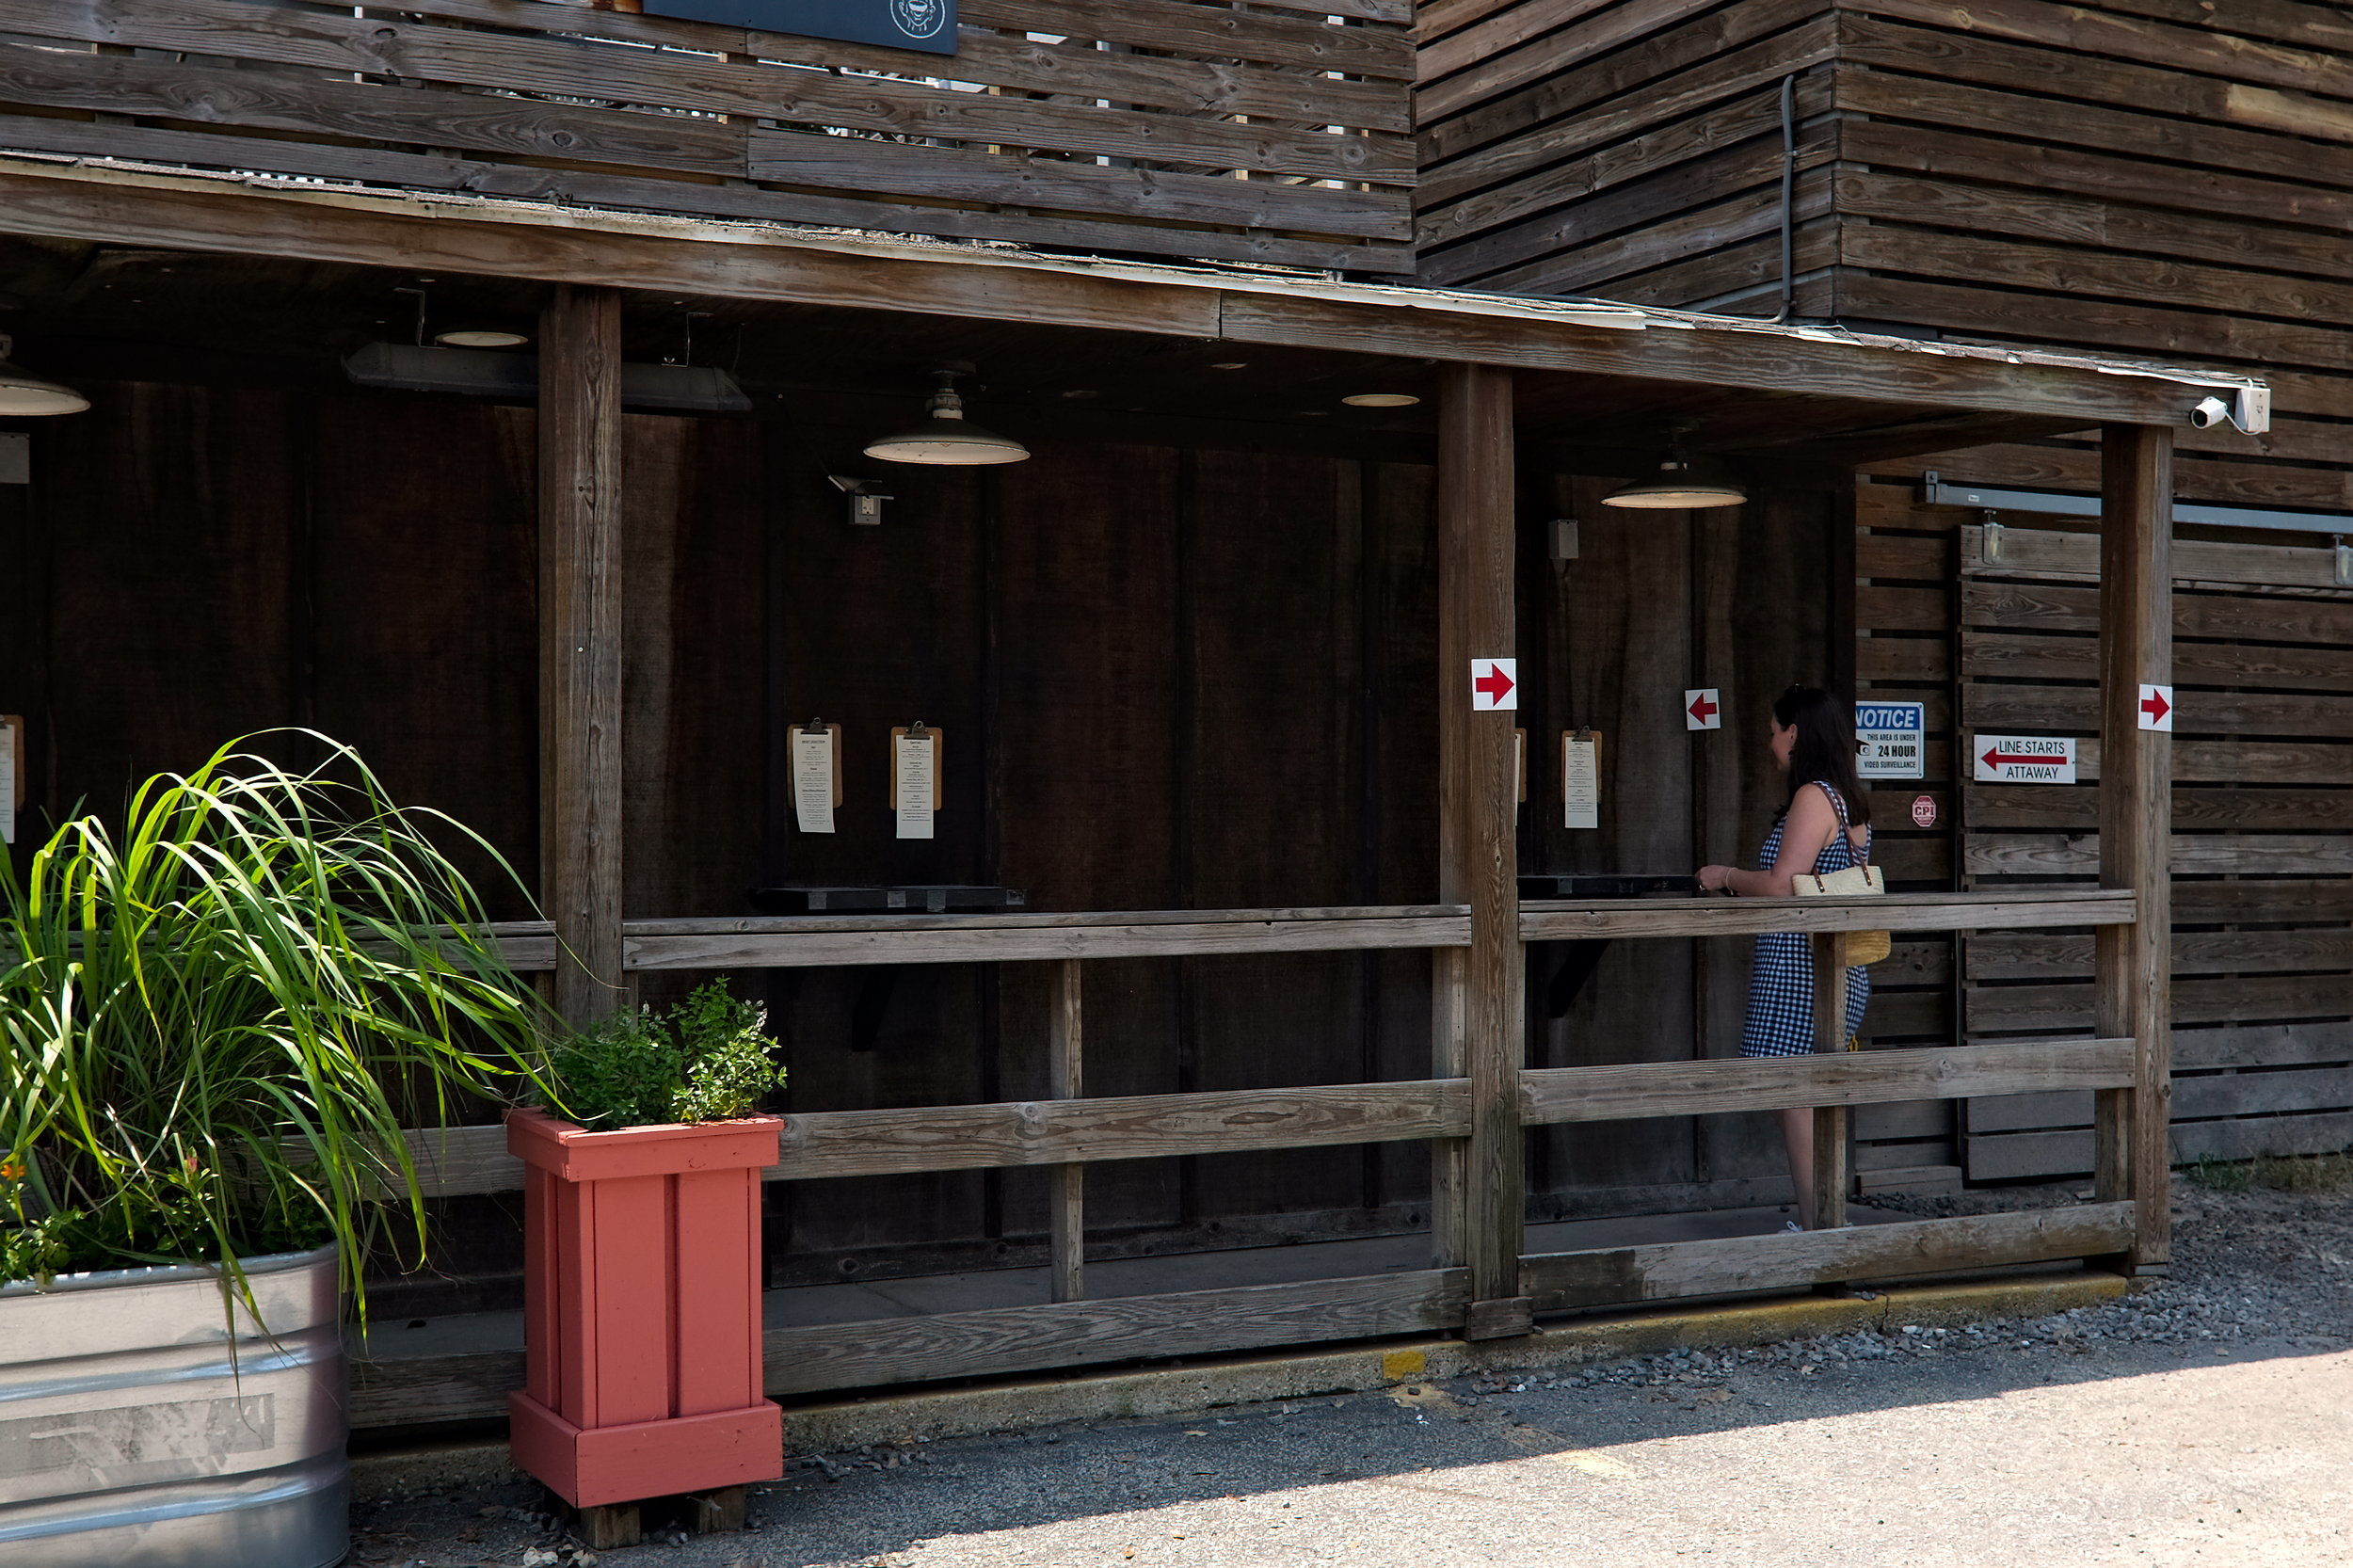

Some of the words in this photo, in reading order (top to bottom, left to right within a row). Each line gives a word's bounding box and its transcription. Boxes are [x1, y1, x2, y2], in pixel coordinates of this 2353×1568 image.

[1856, 709, 1915, 728] NOTICE
[1878, 744, 1890, 757] 24
[1891, 744, 1916, 758] HOUR
[1999, 740, 2022, 753] LINE
[2025, 741, 2065, 755] STARTS
[1864, 760, 1880, 769] VIDEO
[1881, 760, 1916, 769] SURVEILLANCE
[2006, 766, 2058, 779] ATTAWAY
[1914, 806, 1934, 816] CPI
